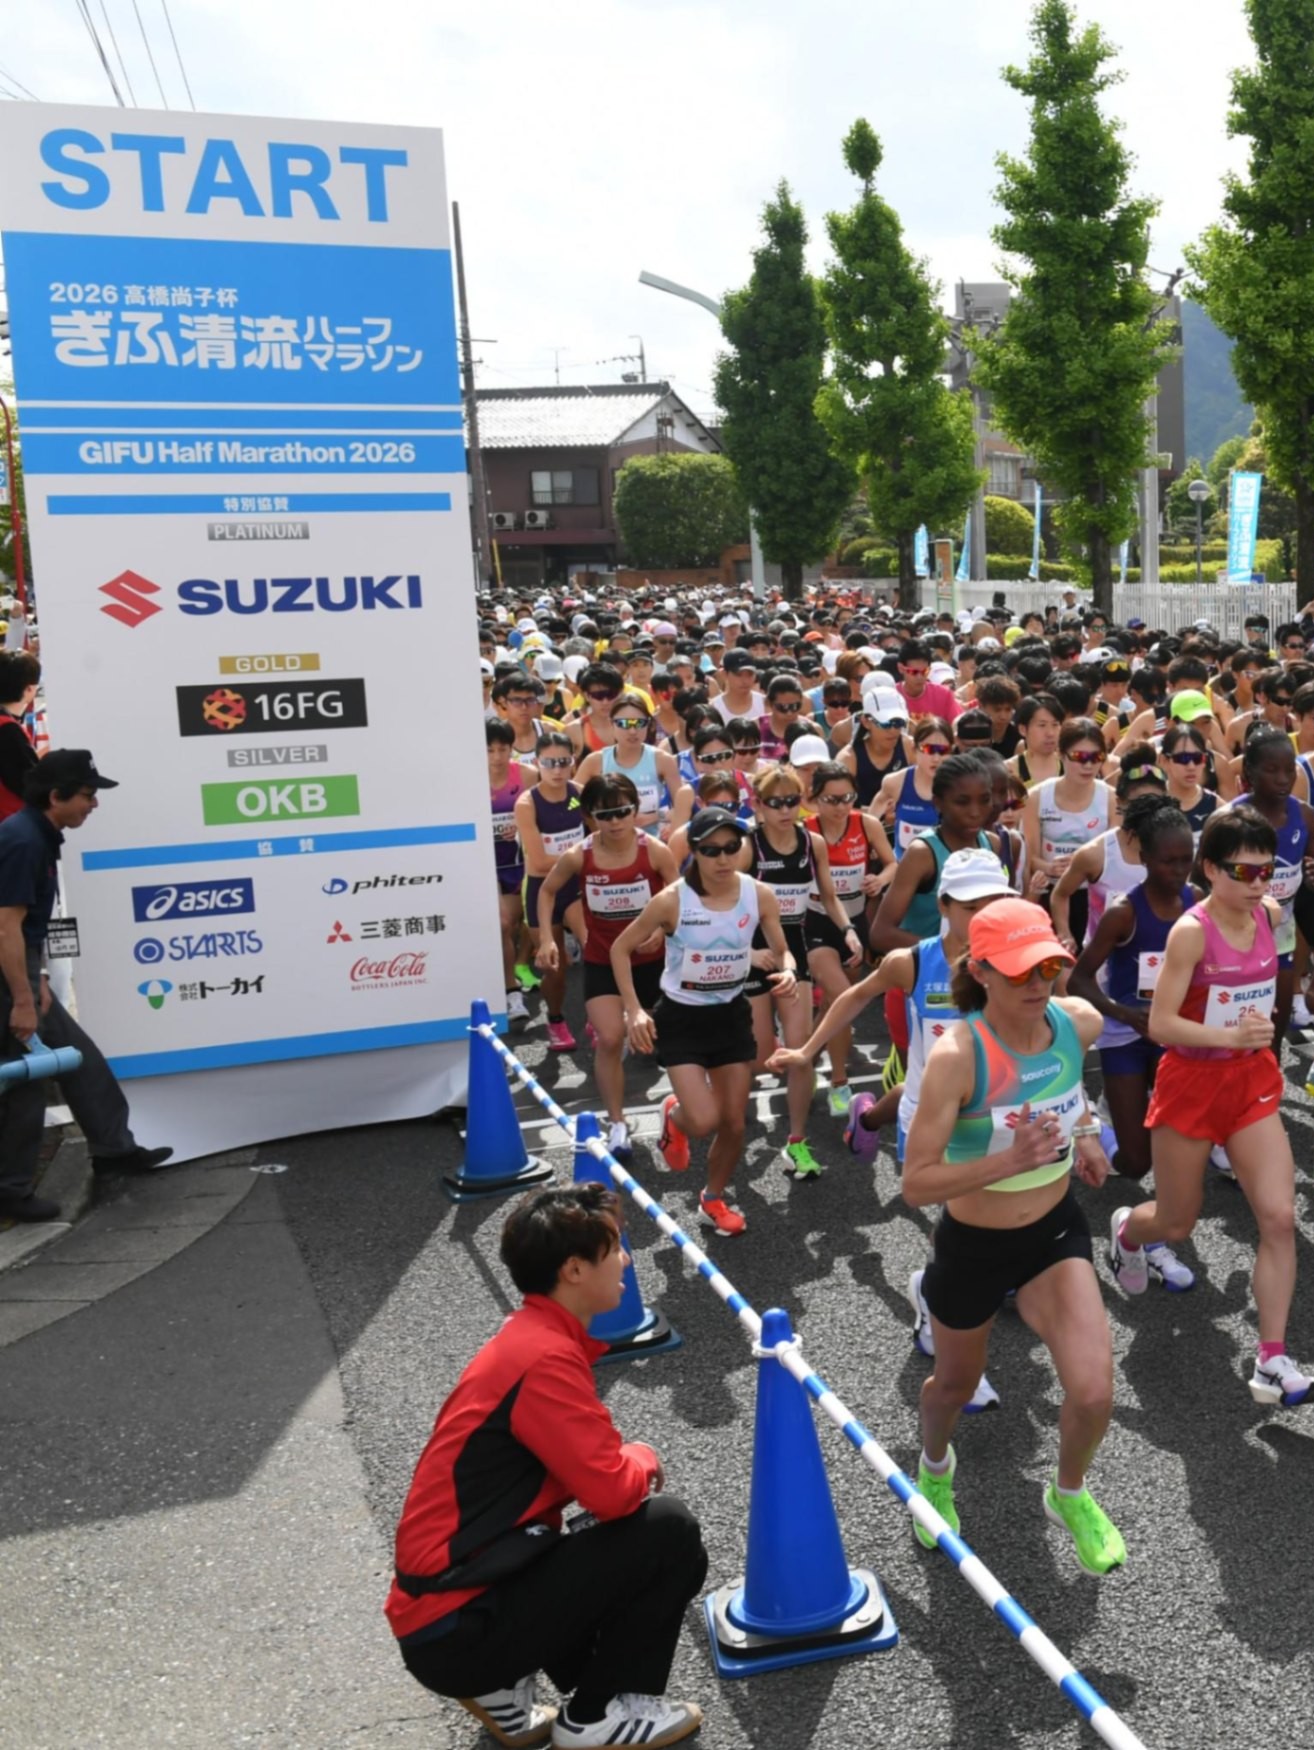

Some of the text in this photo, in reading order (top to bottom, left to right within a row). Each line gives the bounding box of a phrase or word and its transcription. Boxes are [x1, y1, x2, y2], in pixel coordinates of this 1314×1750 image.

[39, 128, 408, 222] START
[49, 283, 238, 309] 2026 高橋尚子杯
[50, 310, 301, 370] ぎふ清流
[303, 316, 393, 344] ハーフ
[303, 343, 424, 372] マラソン
[79, 441, 416, 465] GIFU Half Marathon 2026
[223, 497, 289, 511] 特別協賛
[214, 523, 302, 539] PLATINUM
[177, 575, 423, 615] SUZUKI
[235, 656, 300, 672] GOLD
[254, 690, 344, 721] 16FG
[234, 746, 320, 766] SILVER
[236, 783, 327, 817] OKB
[257, 838, 315, 856] 協賛
[830, 868, 862, 876] UZUKI
[351, 874, 443, 895] phiten
[602, 885, 645, 896] SUZUKI
[775, 886, 809, 896] SUZUKI
[178, 887, 244, 912] asics
[360, 914, 446, 939] 三菱商事
[705, 951, 748, 962] SUZUKI
[707, 965, 732, 976] 207
[199, 975, 265, 999] トーカイ
[351, 982, 389, 991] BOTTLERS
[390, 979, 413, 989] JAPAN
[1021, 1062, 1062, 1083] saucony
